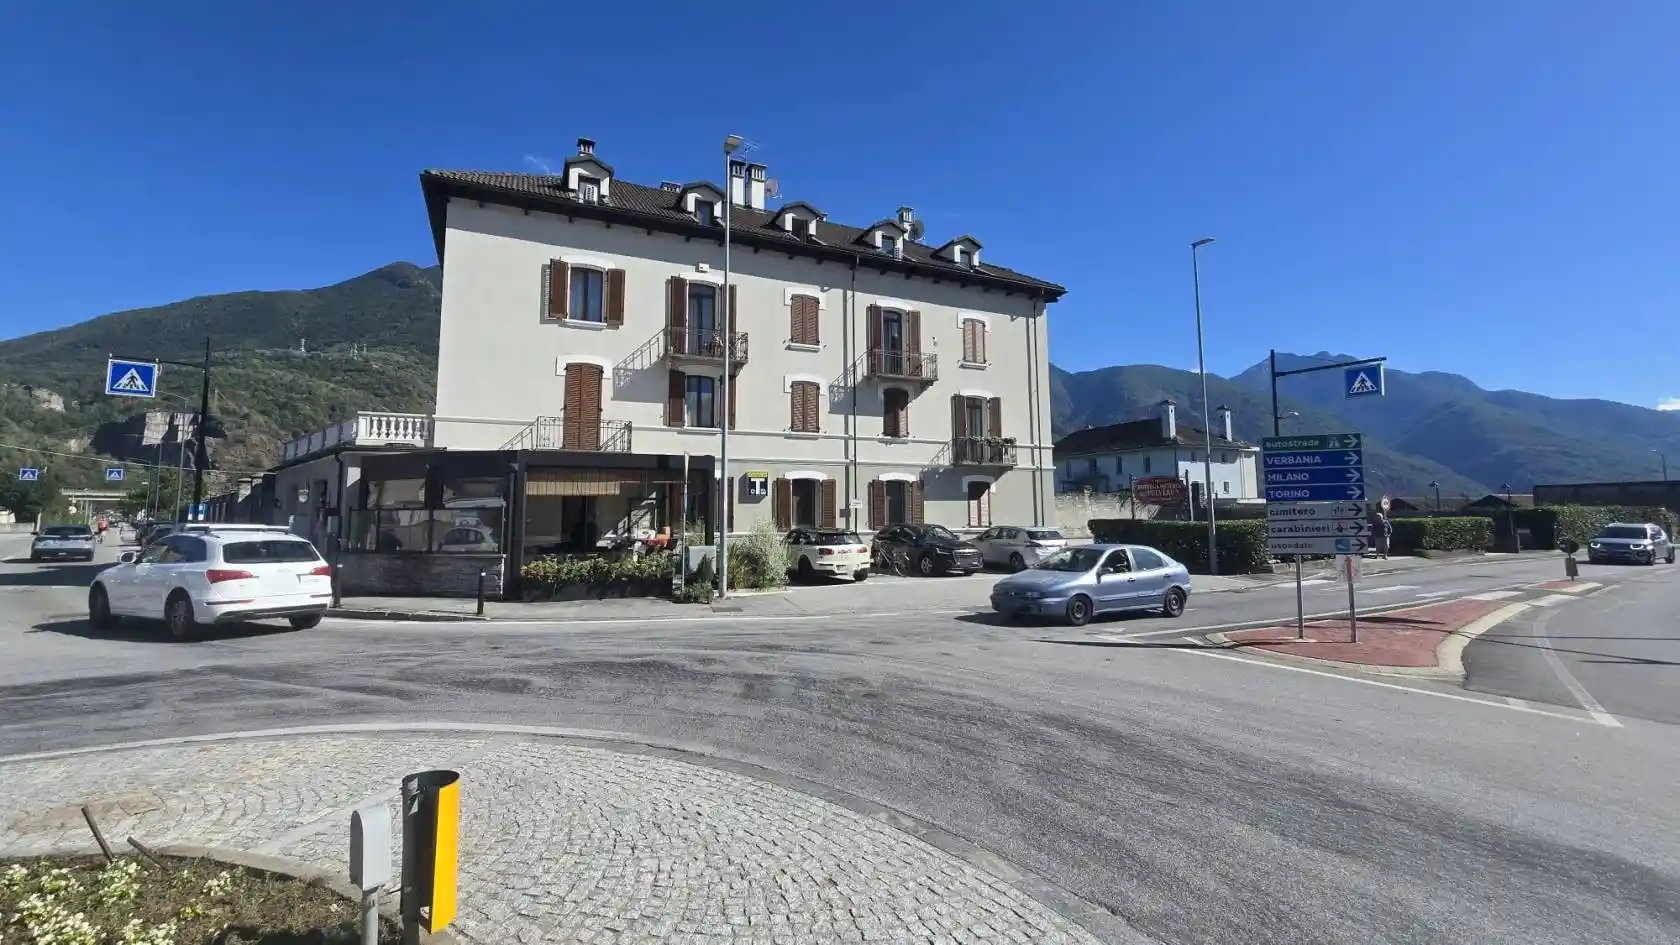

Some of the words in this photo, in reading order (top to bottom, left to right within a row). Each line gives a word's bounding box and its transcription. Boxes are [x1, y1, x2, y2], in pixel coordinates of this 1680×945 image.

[1266, 455, 1322, 465] VERBANIA
[1267, 472, 1310, 482] MILANO
[1268, 489, 1310, 499] TORINO
[1269, 507, 1316, 517] cimitero
[1271, 523, 1331, 533] carabinieri
